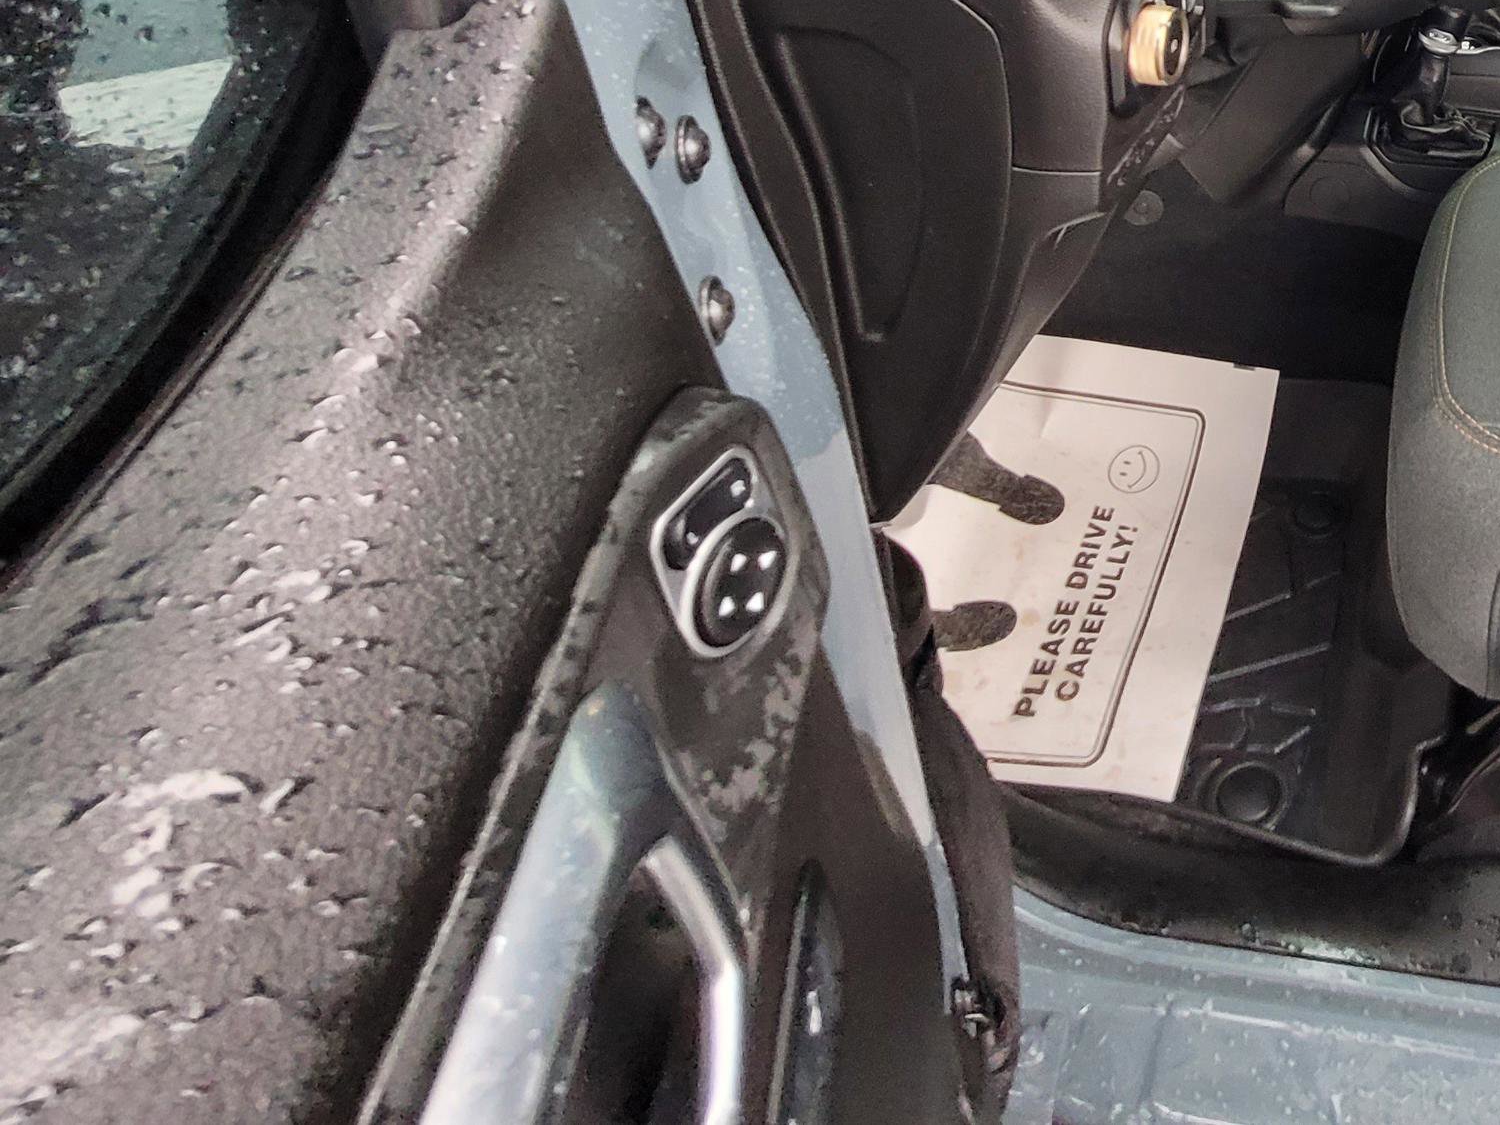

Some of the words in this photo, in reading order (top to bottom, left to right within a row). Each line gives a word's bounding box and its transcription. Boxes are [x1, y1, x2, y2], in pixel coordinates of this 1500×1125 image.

[1013, 599, 1080, 718] PLEASE
[1064, 505, 1116, 592] DRIVE
[1054, 523, 1140, 702] CAREFULLY!
